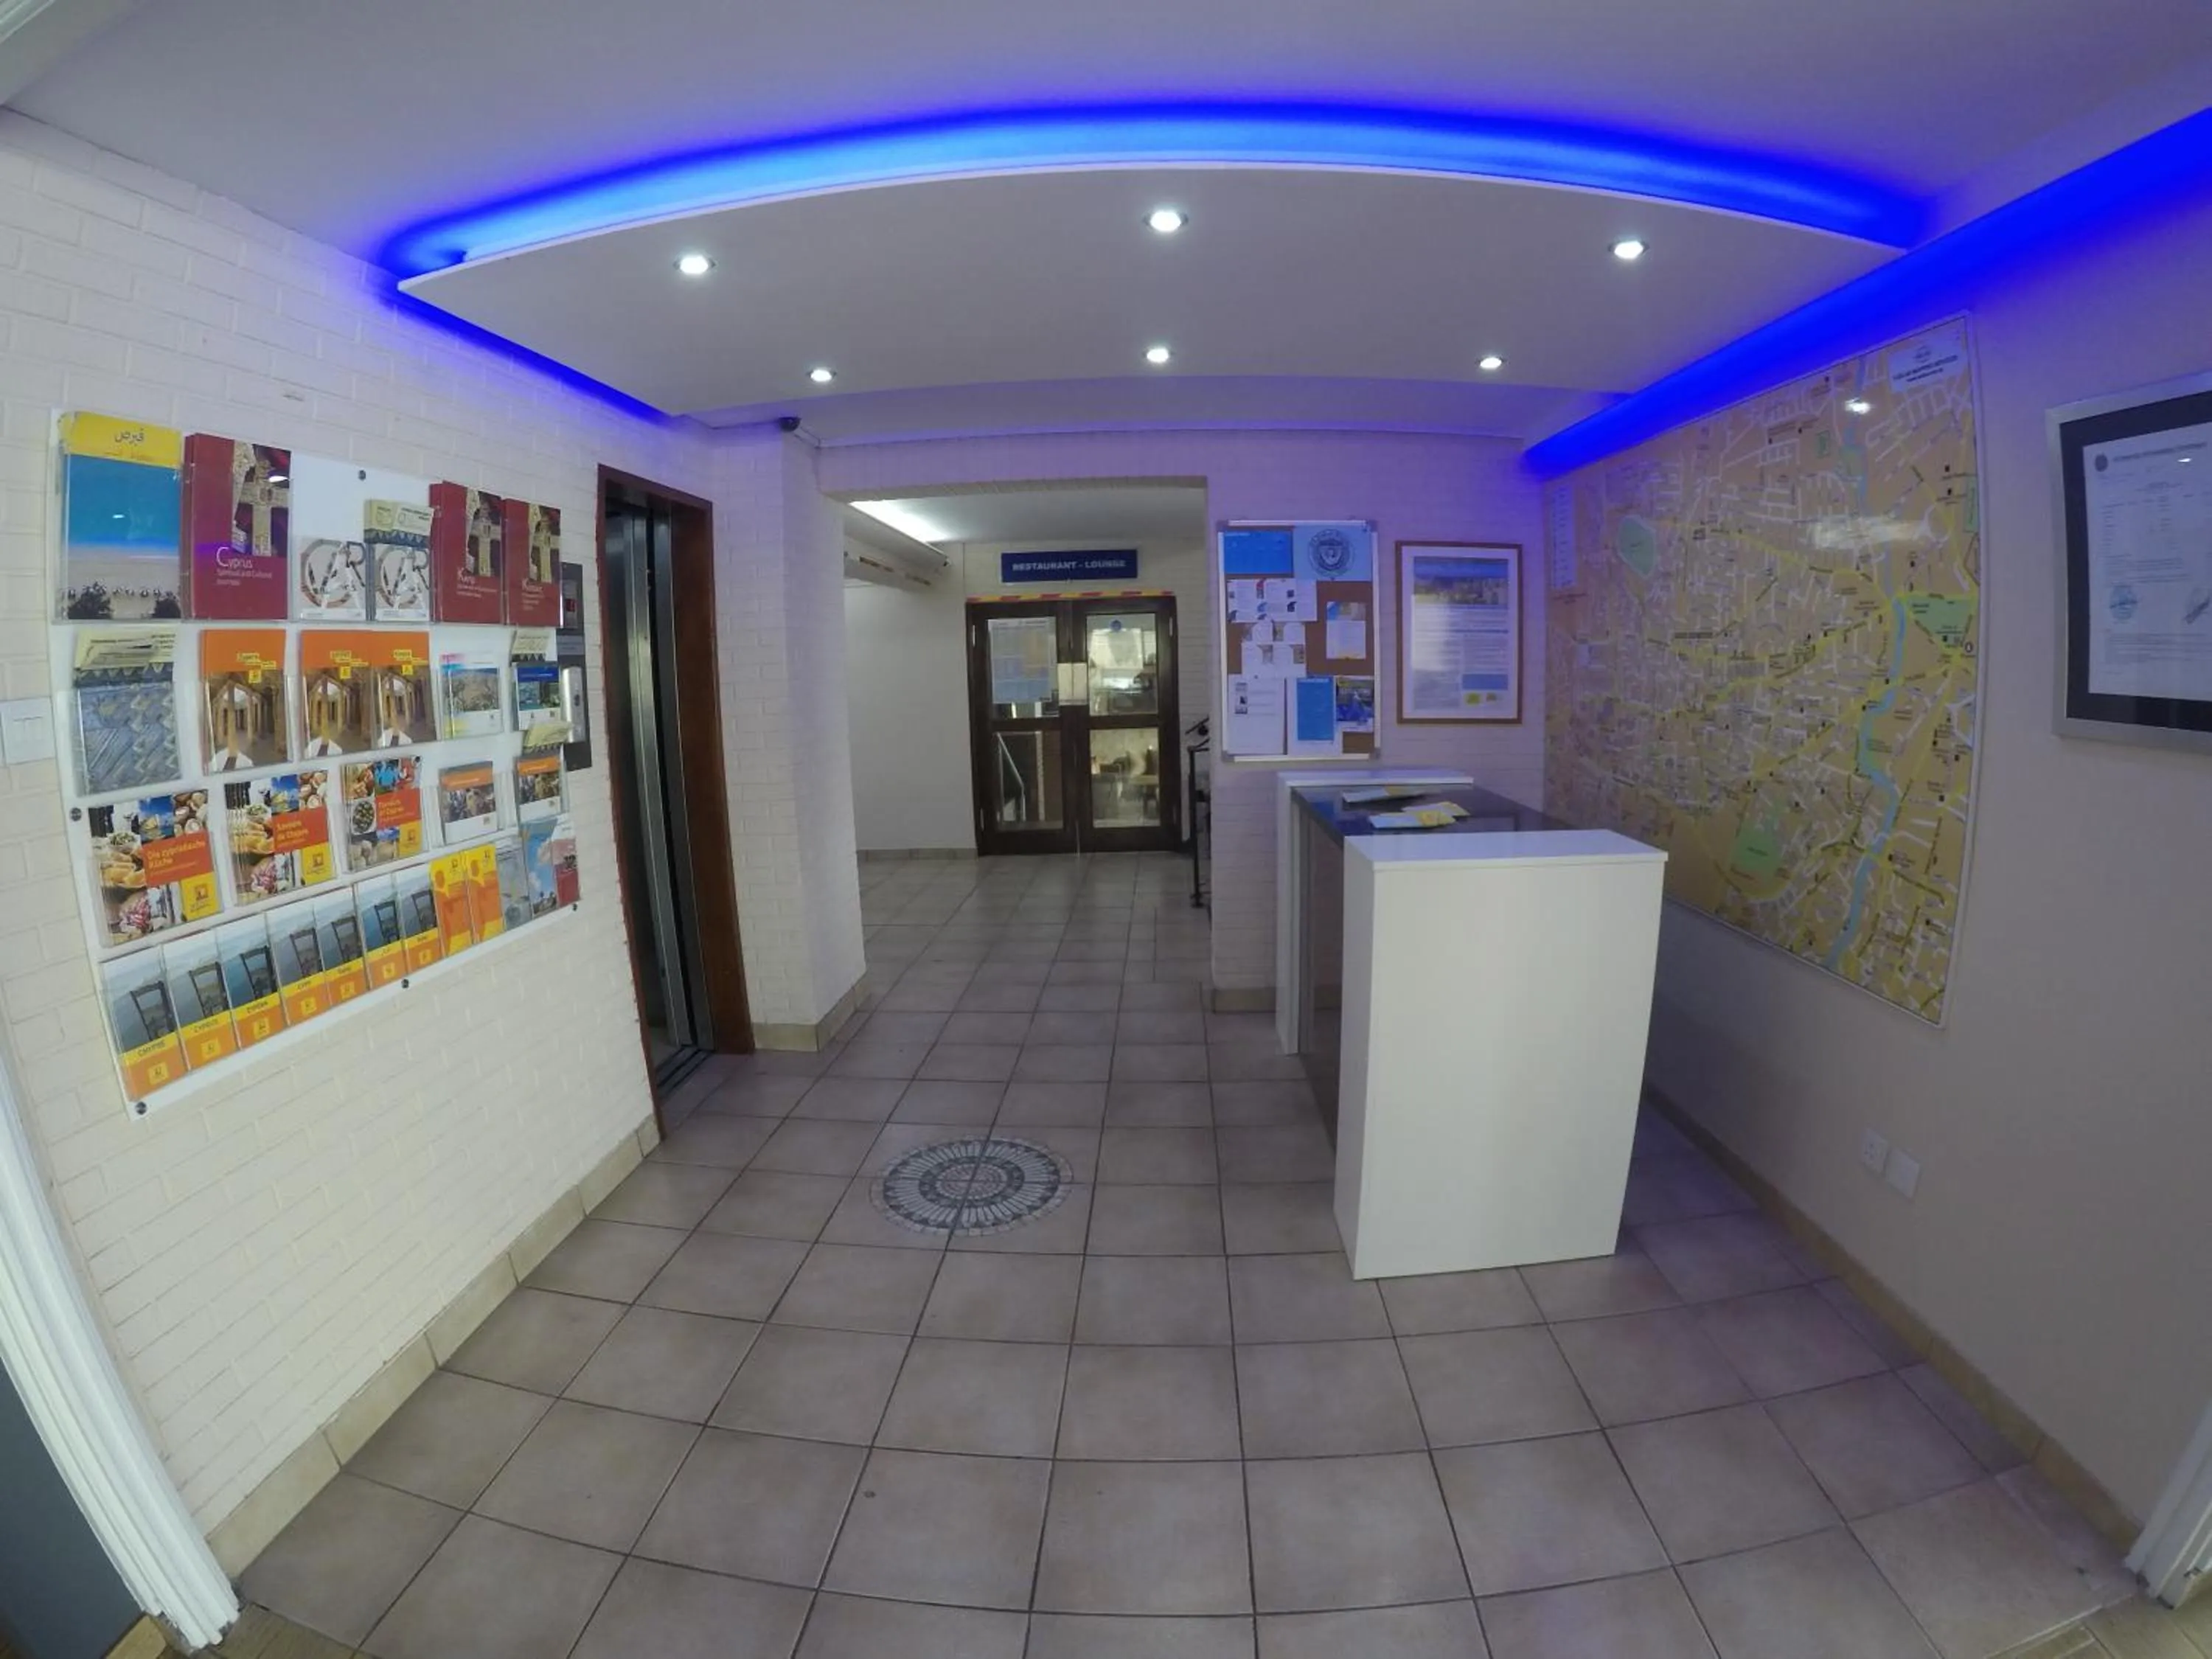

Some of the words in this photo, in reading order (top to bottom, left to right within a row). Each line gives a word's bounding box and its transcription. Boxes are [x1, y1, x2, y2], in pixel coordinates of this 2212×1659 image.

[215, 546, 254, 570] Cyprus
[1012, 560, 1078, 571] RESTAURANT
[1085, 560, 1127, 569] LOUNGE
